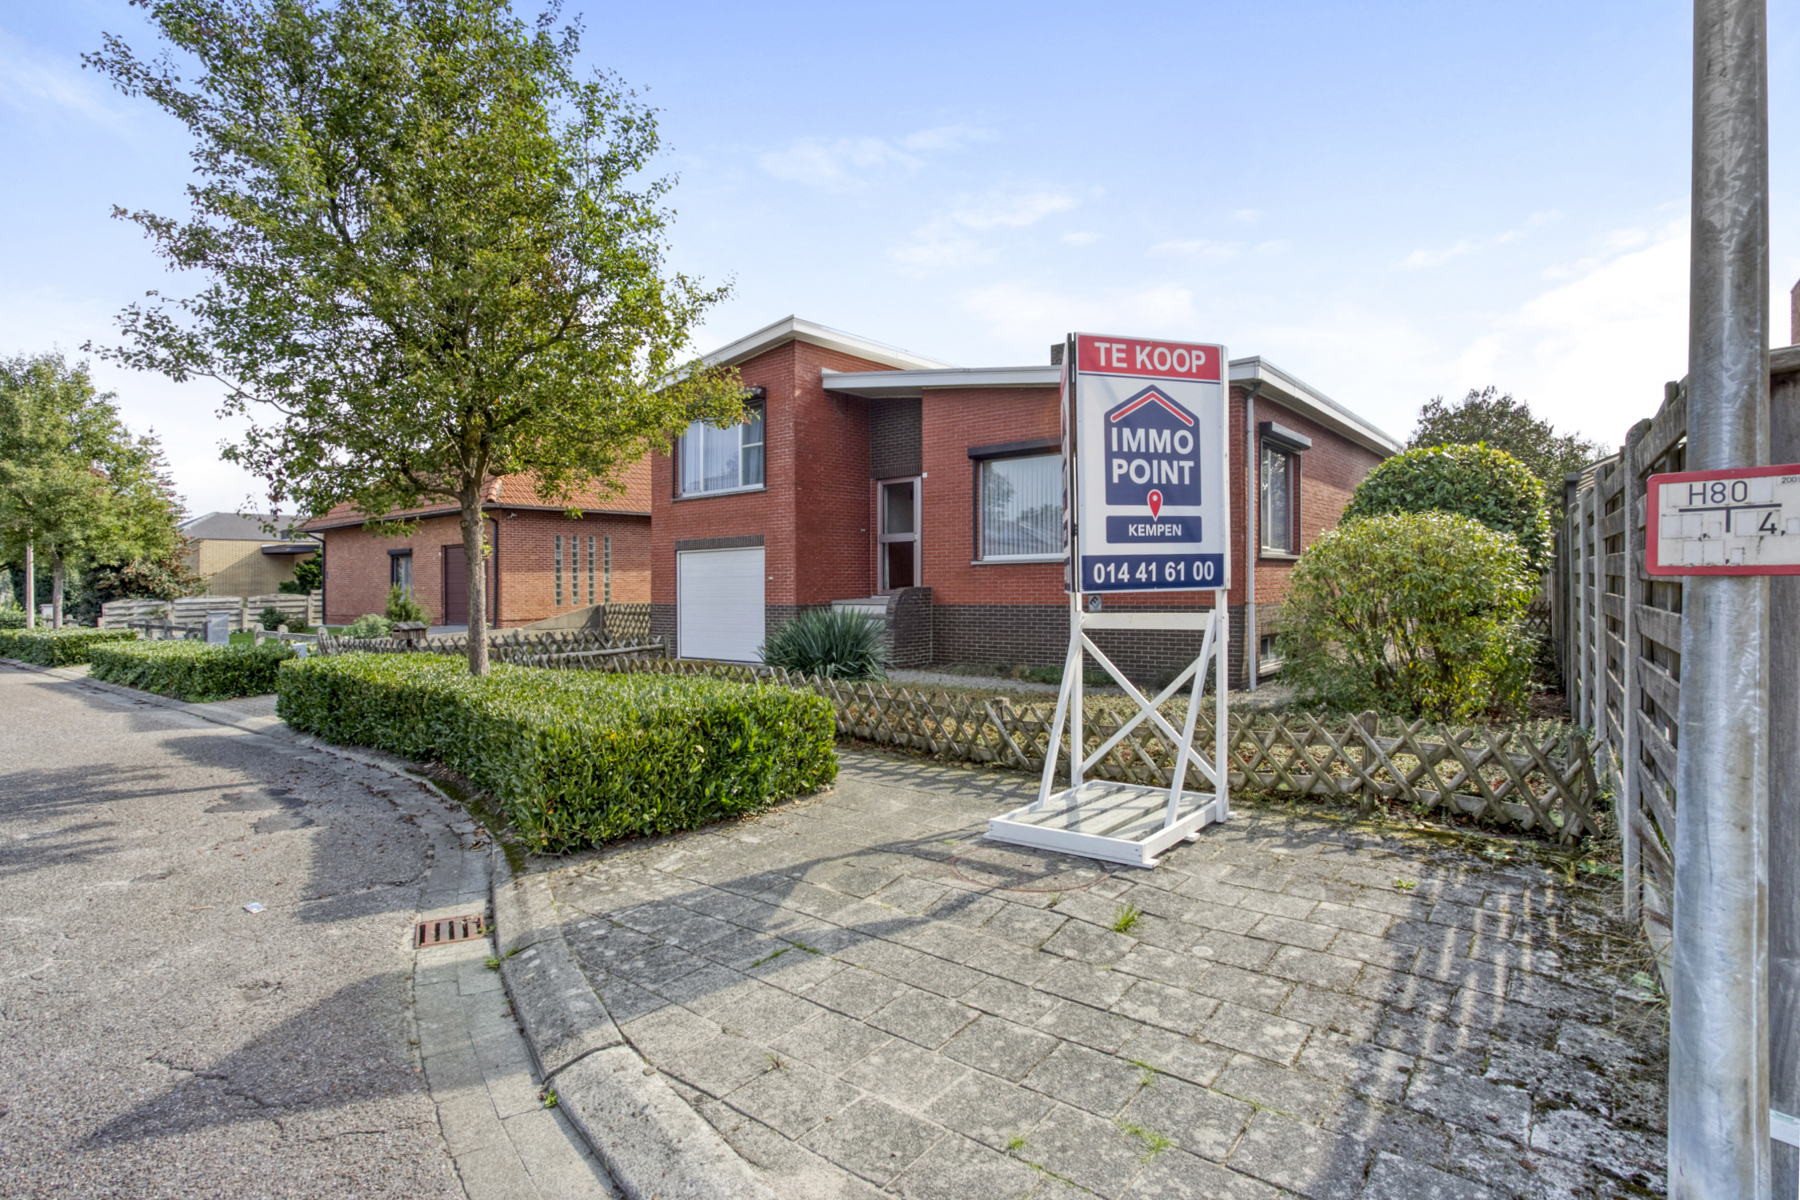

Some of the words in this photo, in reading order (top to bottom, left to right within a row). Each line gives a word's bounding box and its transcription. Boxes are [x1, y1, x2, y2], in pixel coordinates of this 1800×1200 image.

[1094, 341, 1128, 368] TE
[1135, 345, 1206, 373] KOOP
[1111, 427, 1194, 455] IMMO
[1112, 458, 1194, 485] POINT
[1689, 480, 1748, 505] H80
[1128, 523, 1182, 537] KEMPEN
[1093, 562, 1130, 584] 014
[1135, 562, 1157, 582] 41
[1164, 561, 1185, 581] 61
[1193, 561, 1214, 581] 00
